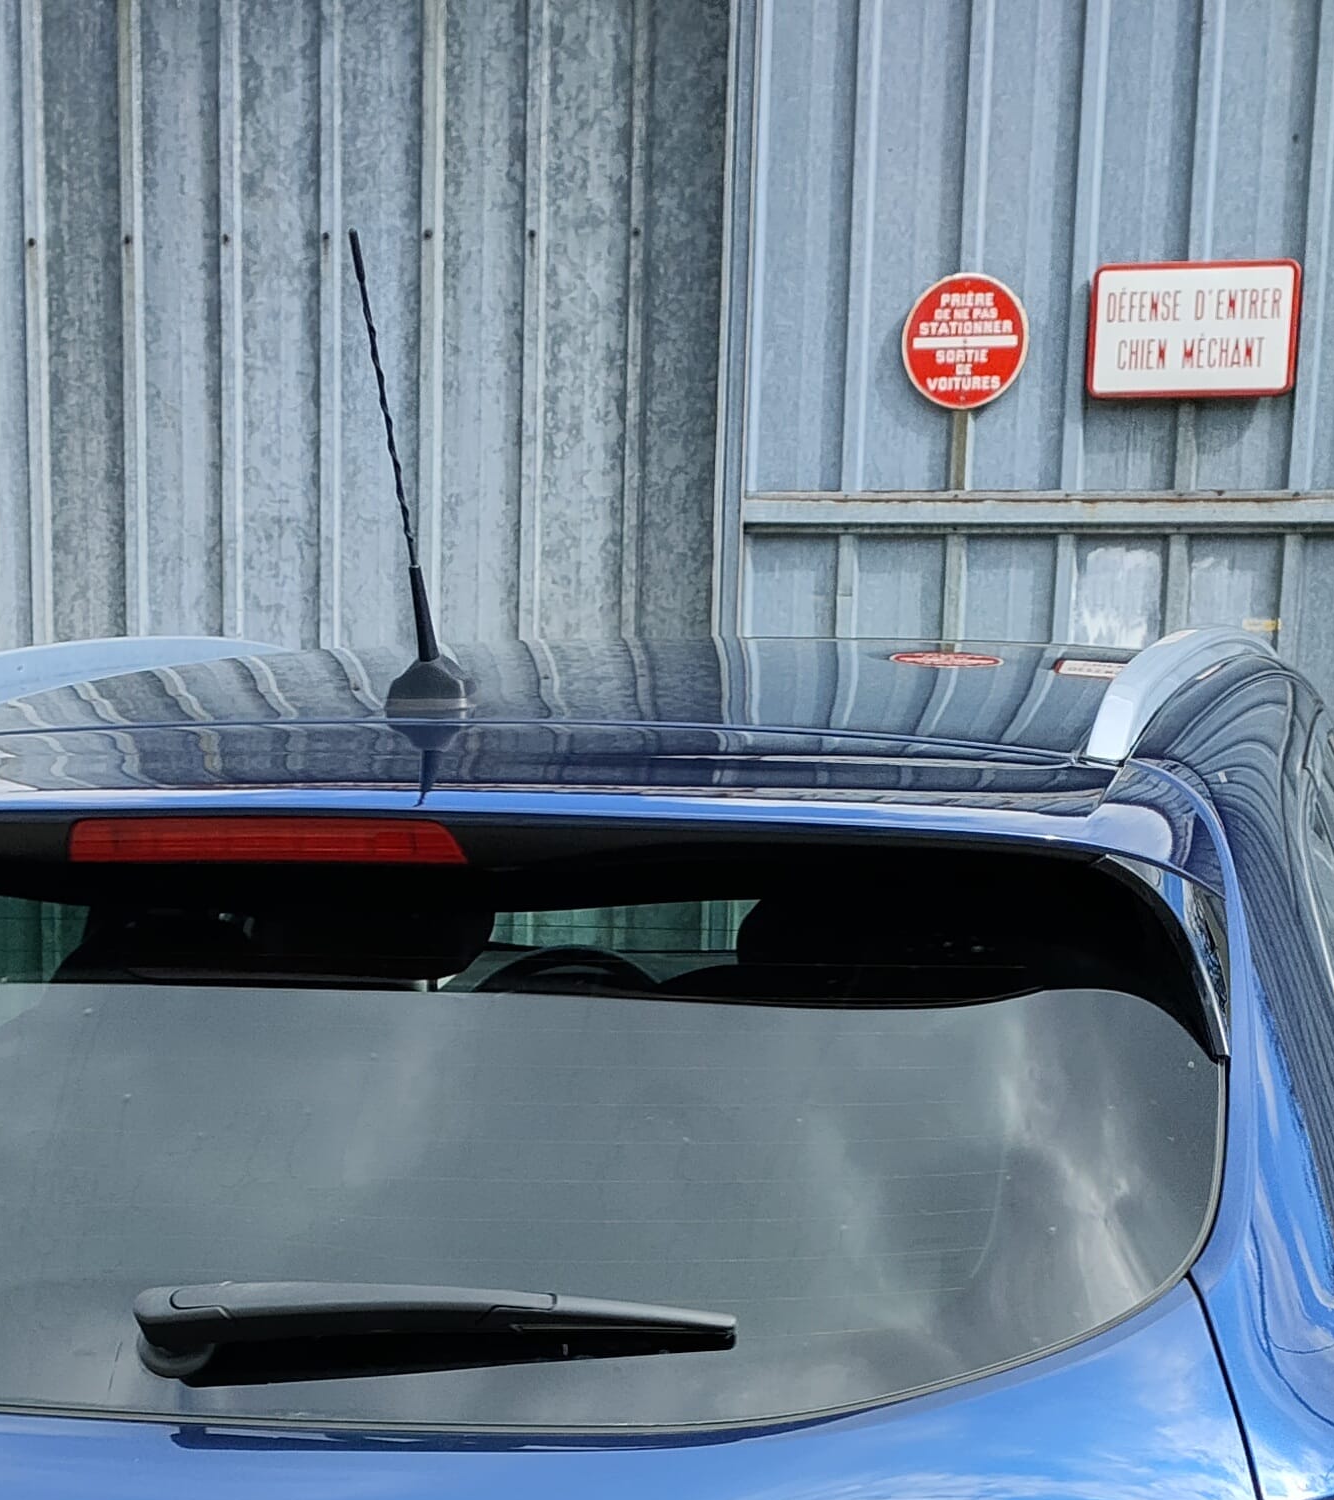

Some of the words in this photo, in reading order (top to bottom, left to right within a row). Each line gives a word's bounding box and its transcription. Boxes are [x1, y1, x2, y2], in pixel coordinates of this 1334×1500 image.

[1106, 287, 1182, 323] DÉFENSE
[1194, 288, 1283, 321] D'ENTRER
[934, 308, 951, 320] DE
[953, 308, 970, 320] NE
[972, 307, 998, 319] PAS
[919, 320, 1013, 335] STATIONNER
[935, 349, 988, 364] SORTIE
[1117, 337, 1168, 371] CHIEN
[1181, 332, 1266, 369] MÉCHANT
[955, 363, 973, 375] DE
[926, 375, 1001, 391] VOITURES
